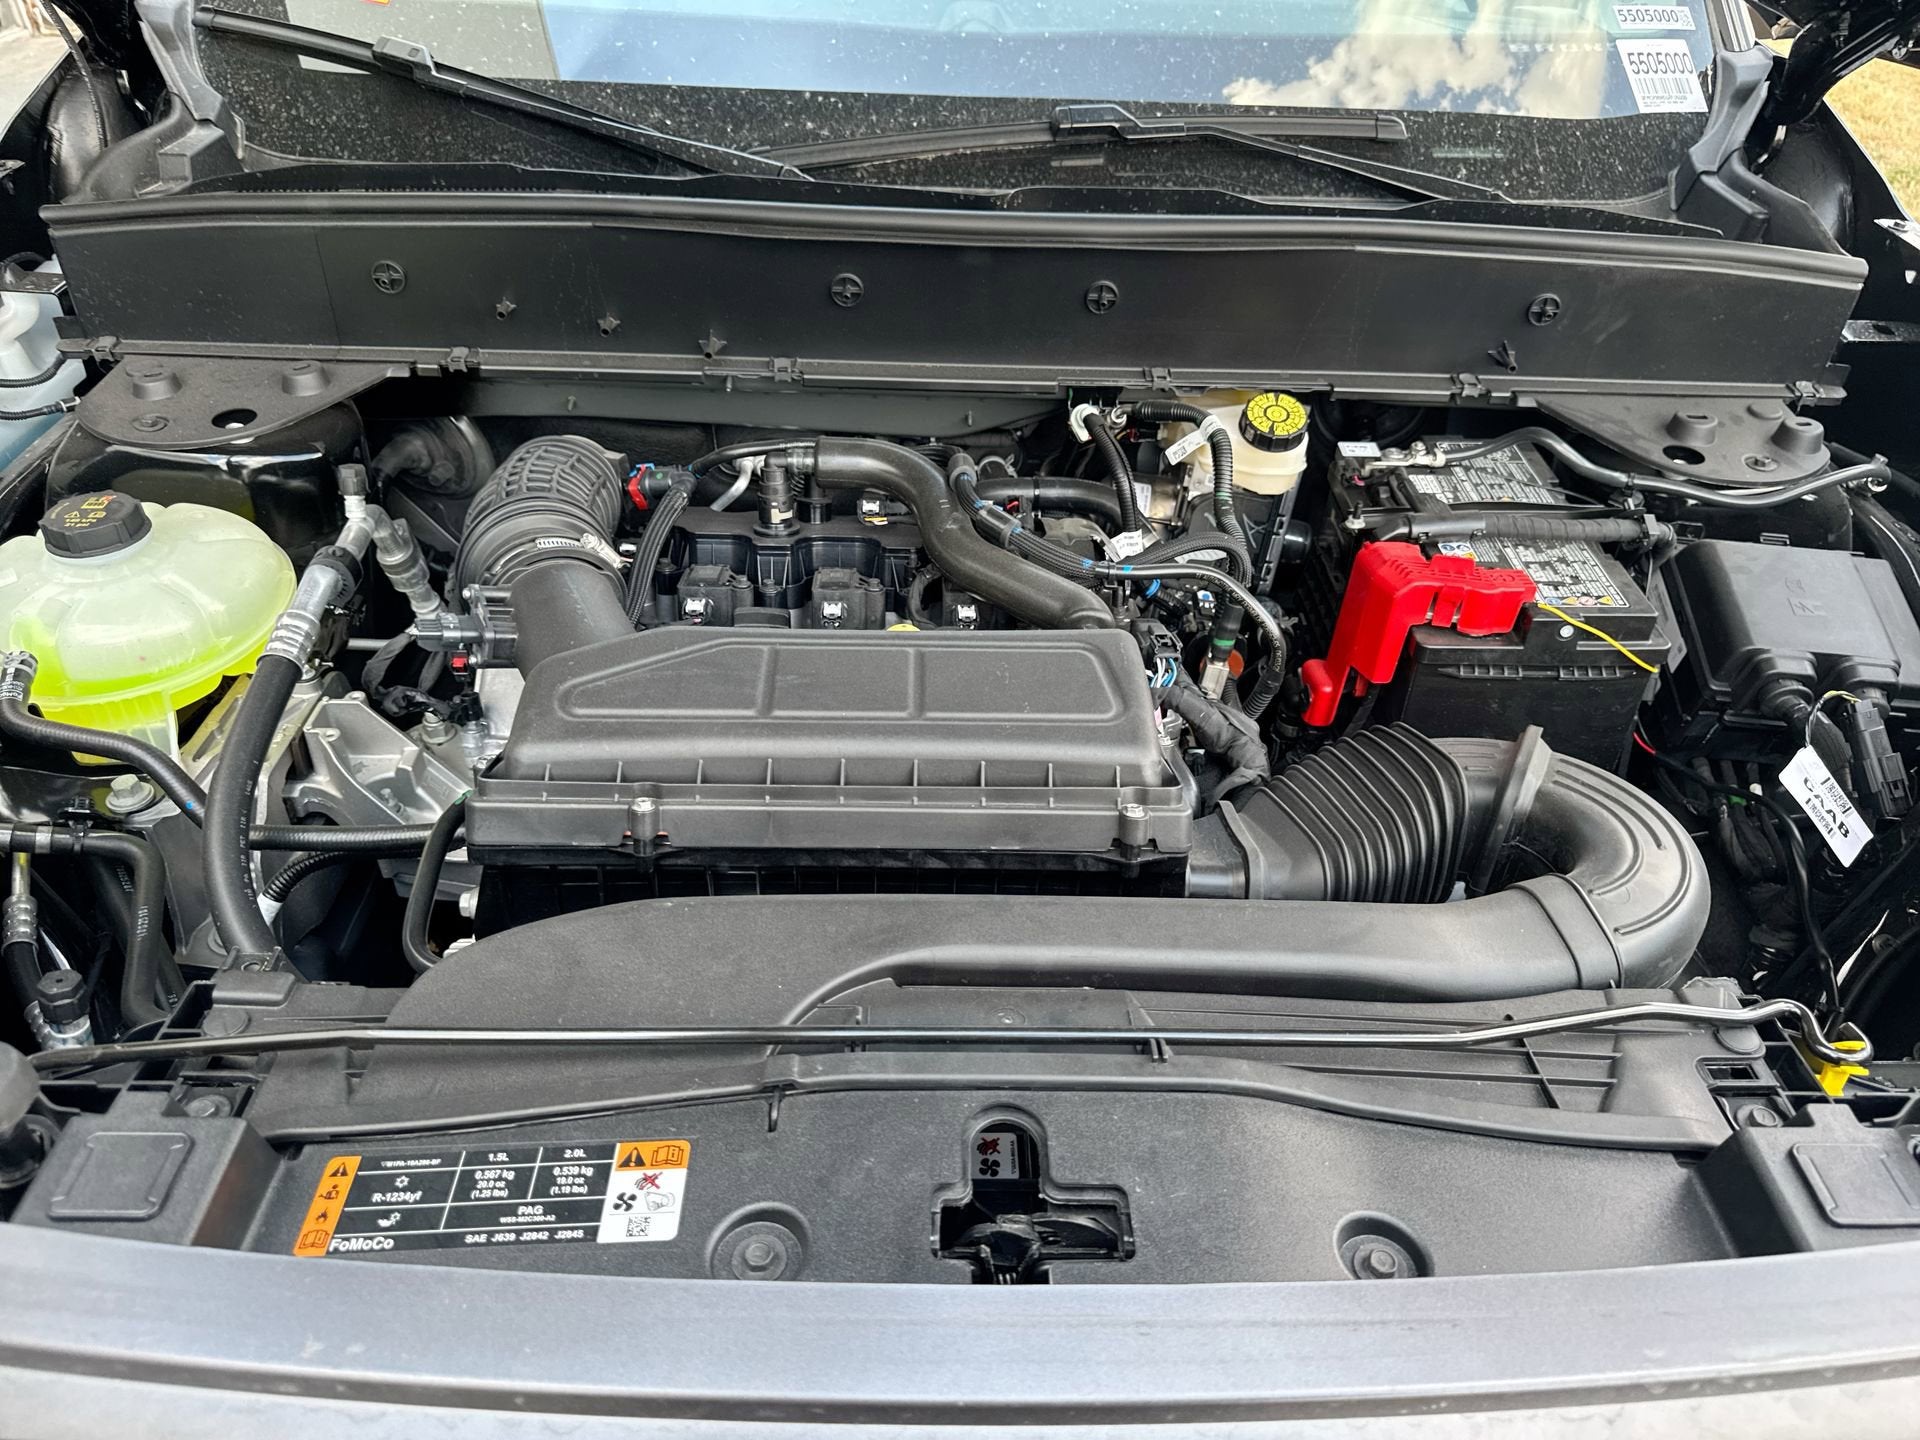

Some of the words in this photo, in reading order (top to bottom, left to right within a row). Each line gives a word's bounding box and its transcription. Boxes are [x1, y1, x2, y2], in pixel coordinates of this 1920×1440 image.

[1617, 9, 1679, 22] 5505000
[1627, 52, 1694, 74] 5505000
[1803, 777, 1850, 839] CAAB
[488, 1152, 510, 1162] 1.5L
[563, 1148, 587, 1158] 2.0L
[474, 1170, 501, 1181] 0.567
[502, 1169, 516, 1181] kg
[552, 1166, 579, 1177] 0.539
[580, 1165, 594, 1177] kg
[476, 1181, 494, 1189] 20.0
[574, 1176, 585, 1184] oz
[471, 1189, 491, 1200] (1.25
[492, 1188, 509, 1198] lbs)
[571, 1185, 588, 1194] lbs)
[372, 1190, 422, 1203] R-1234yf
[517, 1205, 544, 1215] PAG
[464, 1233, 488, 1244] SAE
[490, 1231, 516, 1242] J639
[519, 1230, 550, 1241] J2842
[554, 1229, 584, 1240] J2845
[328, 1236, 395, 1253] FoMoCo
